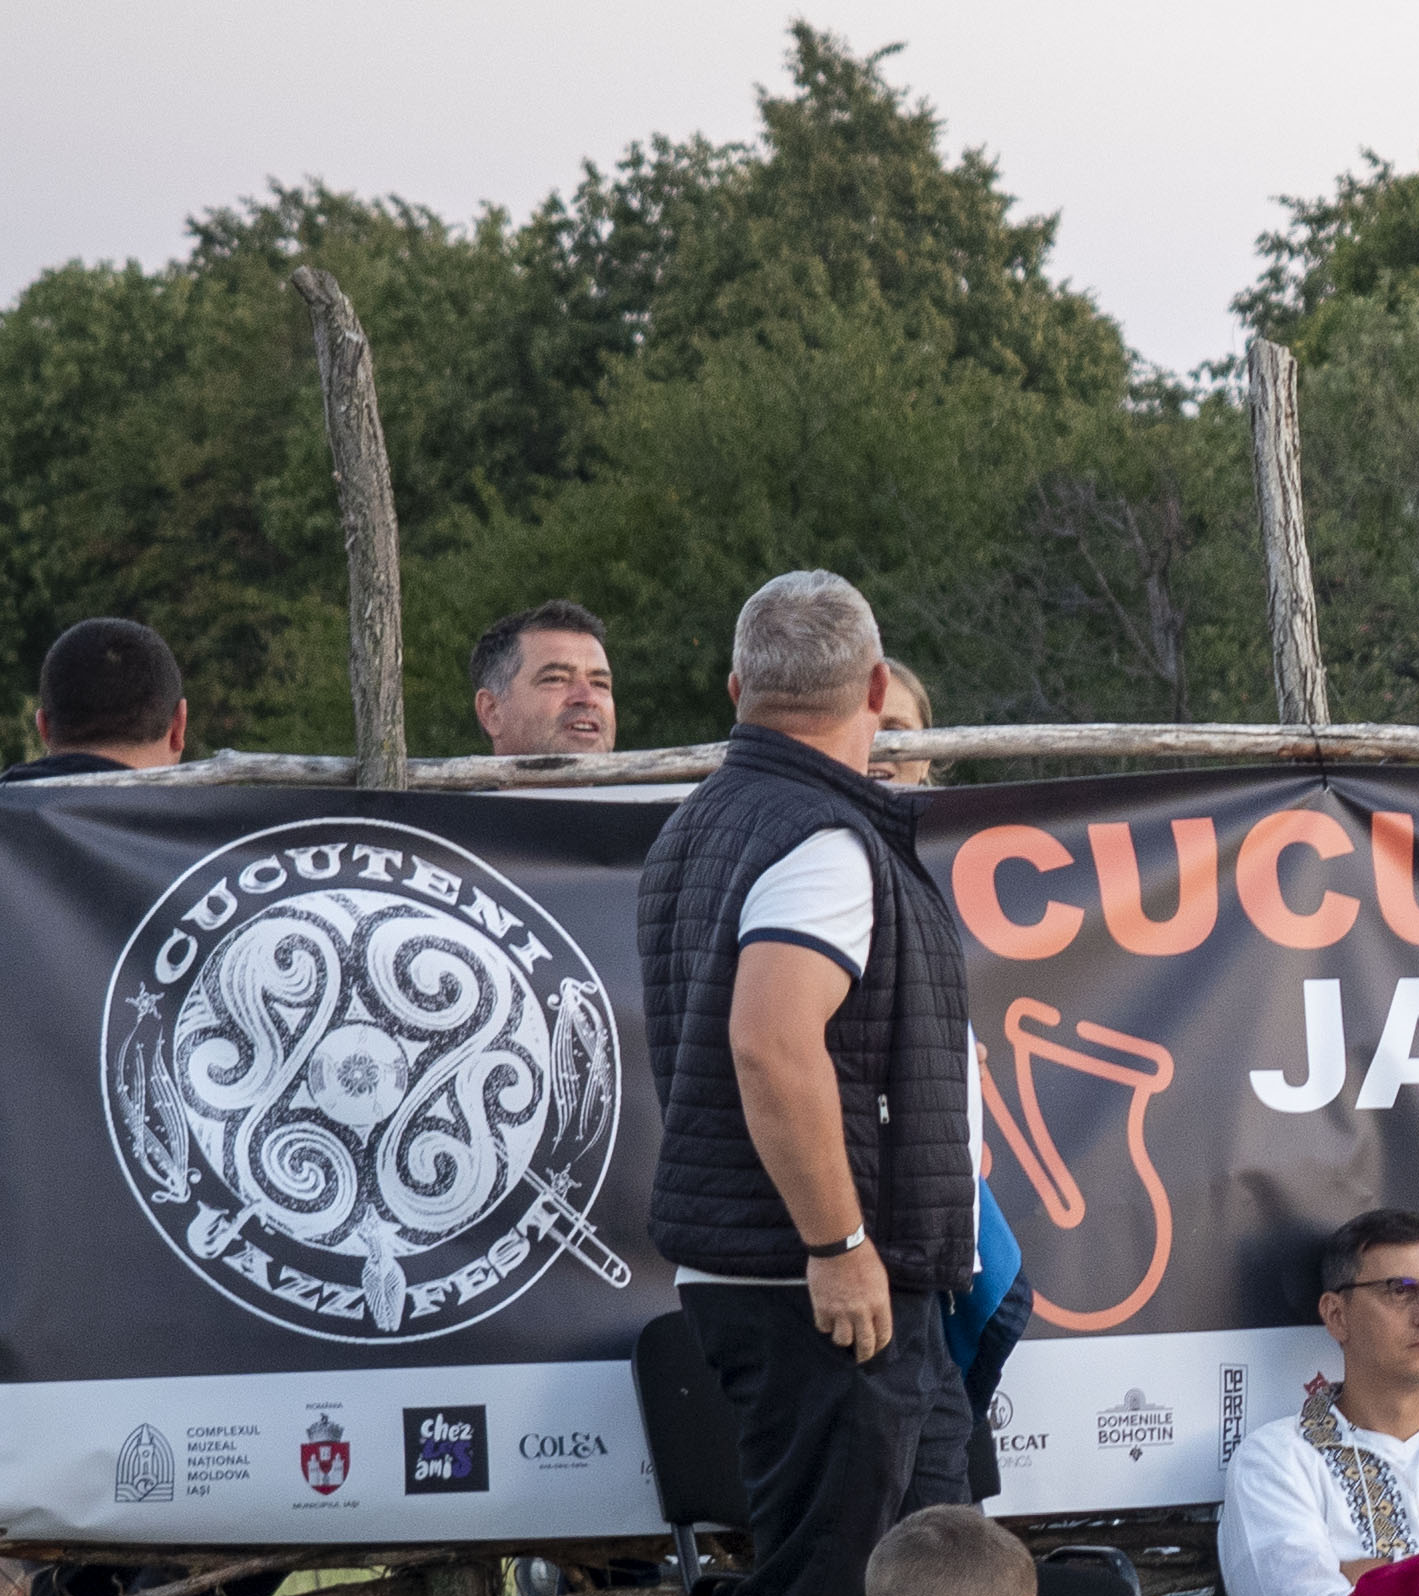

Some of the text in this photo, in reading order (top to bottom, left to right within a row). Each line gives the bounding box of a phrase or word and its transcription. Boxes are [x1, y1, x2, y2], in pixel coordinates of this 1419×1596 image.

[155, 842, 552, 983] CUCUTENI
[188, 1200, 560, 1321] JAZZ FEST
[1097, 1412, 1174, 1428] DOMENIILE
[187, 1425, 261, 1438] COMPLEXUL
[1098, 1427, 1174, 1444] BOHOTIN
[187, 1440, 237, 1452] MUZEAL
[187, 1470, 251, 1482] MOLDOVA
